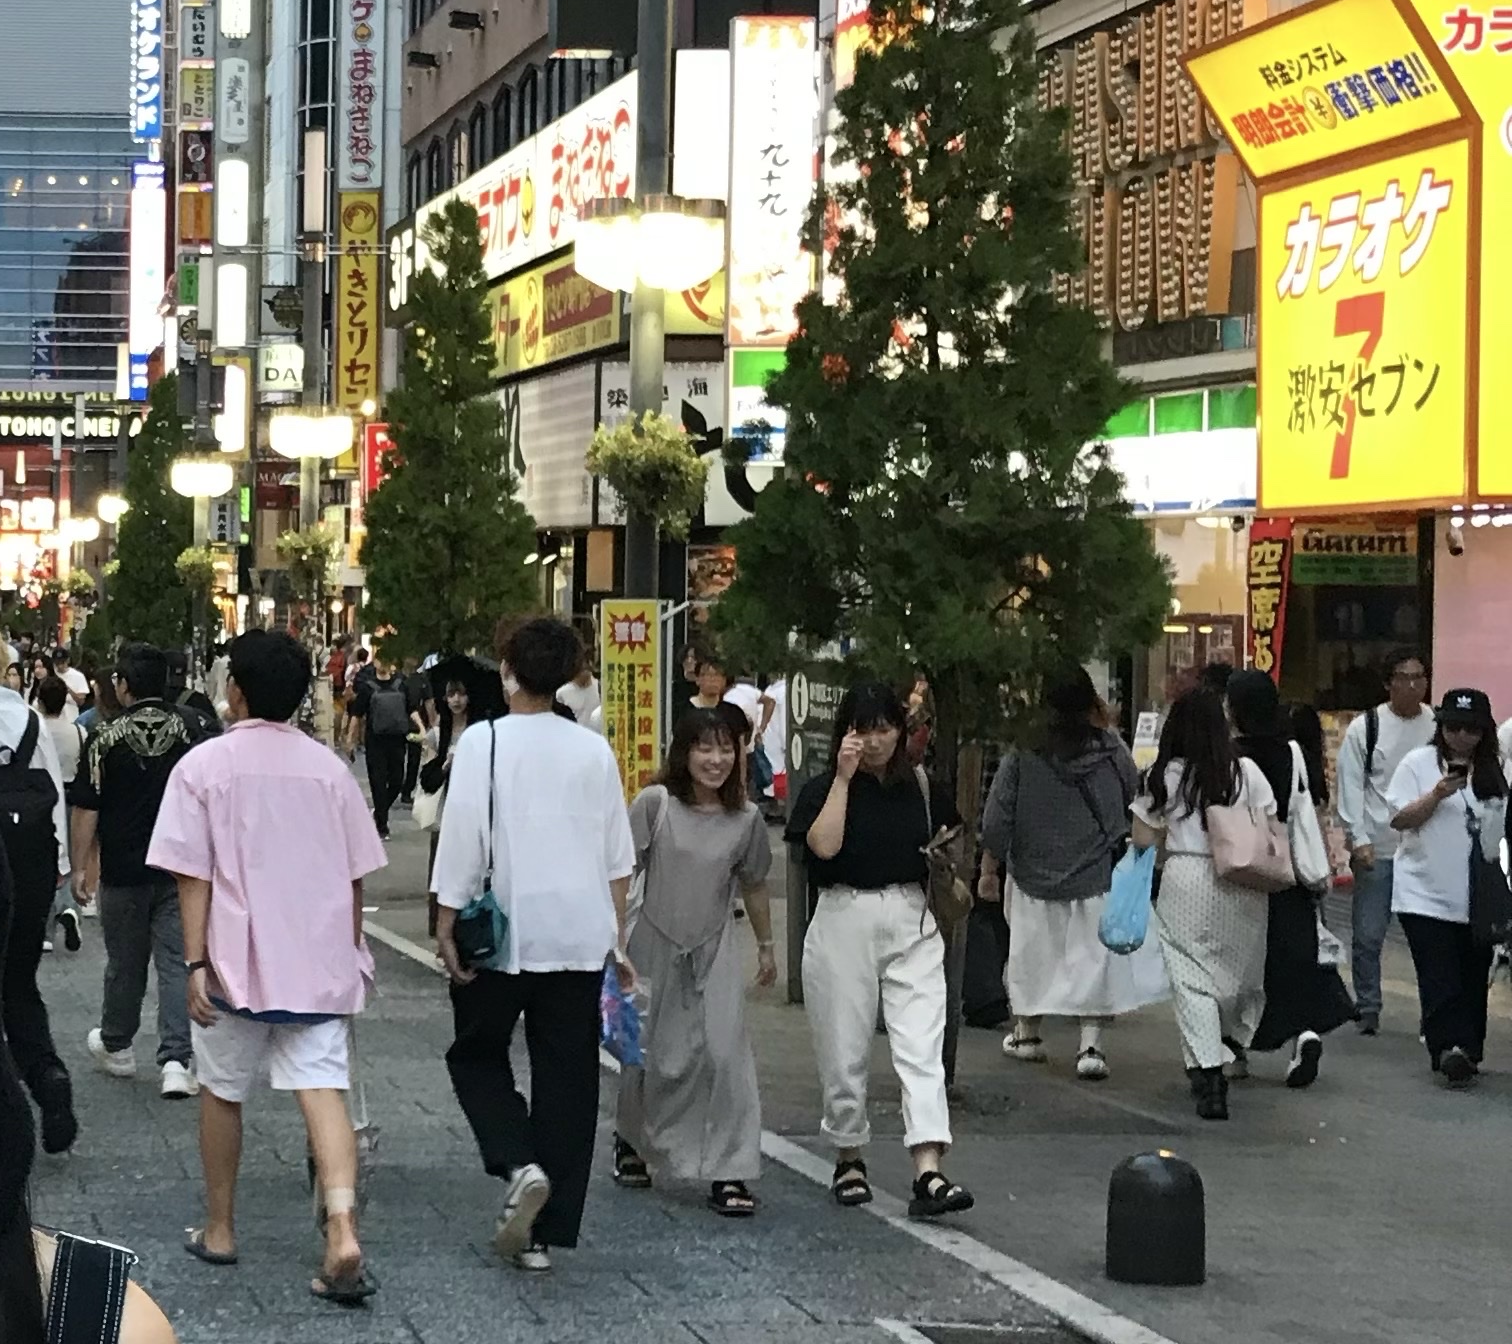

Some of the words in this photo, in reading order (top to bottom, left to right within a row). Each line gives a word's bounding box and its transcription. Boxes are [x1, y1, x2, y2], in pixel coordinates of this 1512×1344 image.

[1258, 42, 1348, 90] 料金システム
[1324, 51, 1438, 122] 衝撃価格!!
[349, 49, 375, 184] まねきねこ
[469, 172, 521, 259] ラオケ
[758, 144, 790, 216] 九十九
[389, 228, 413, 312] 3F
[1276, 168, 1453, 302] カラオケ
[1287, 353, 1440, 434] 激安セブン
[1250, 541, 1284, 674] 空席あ
